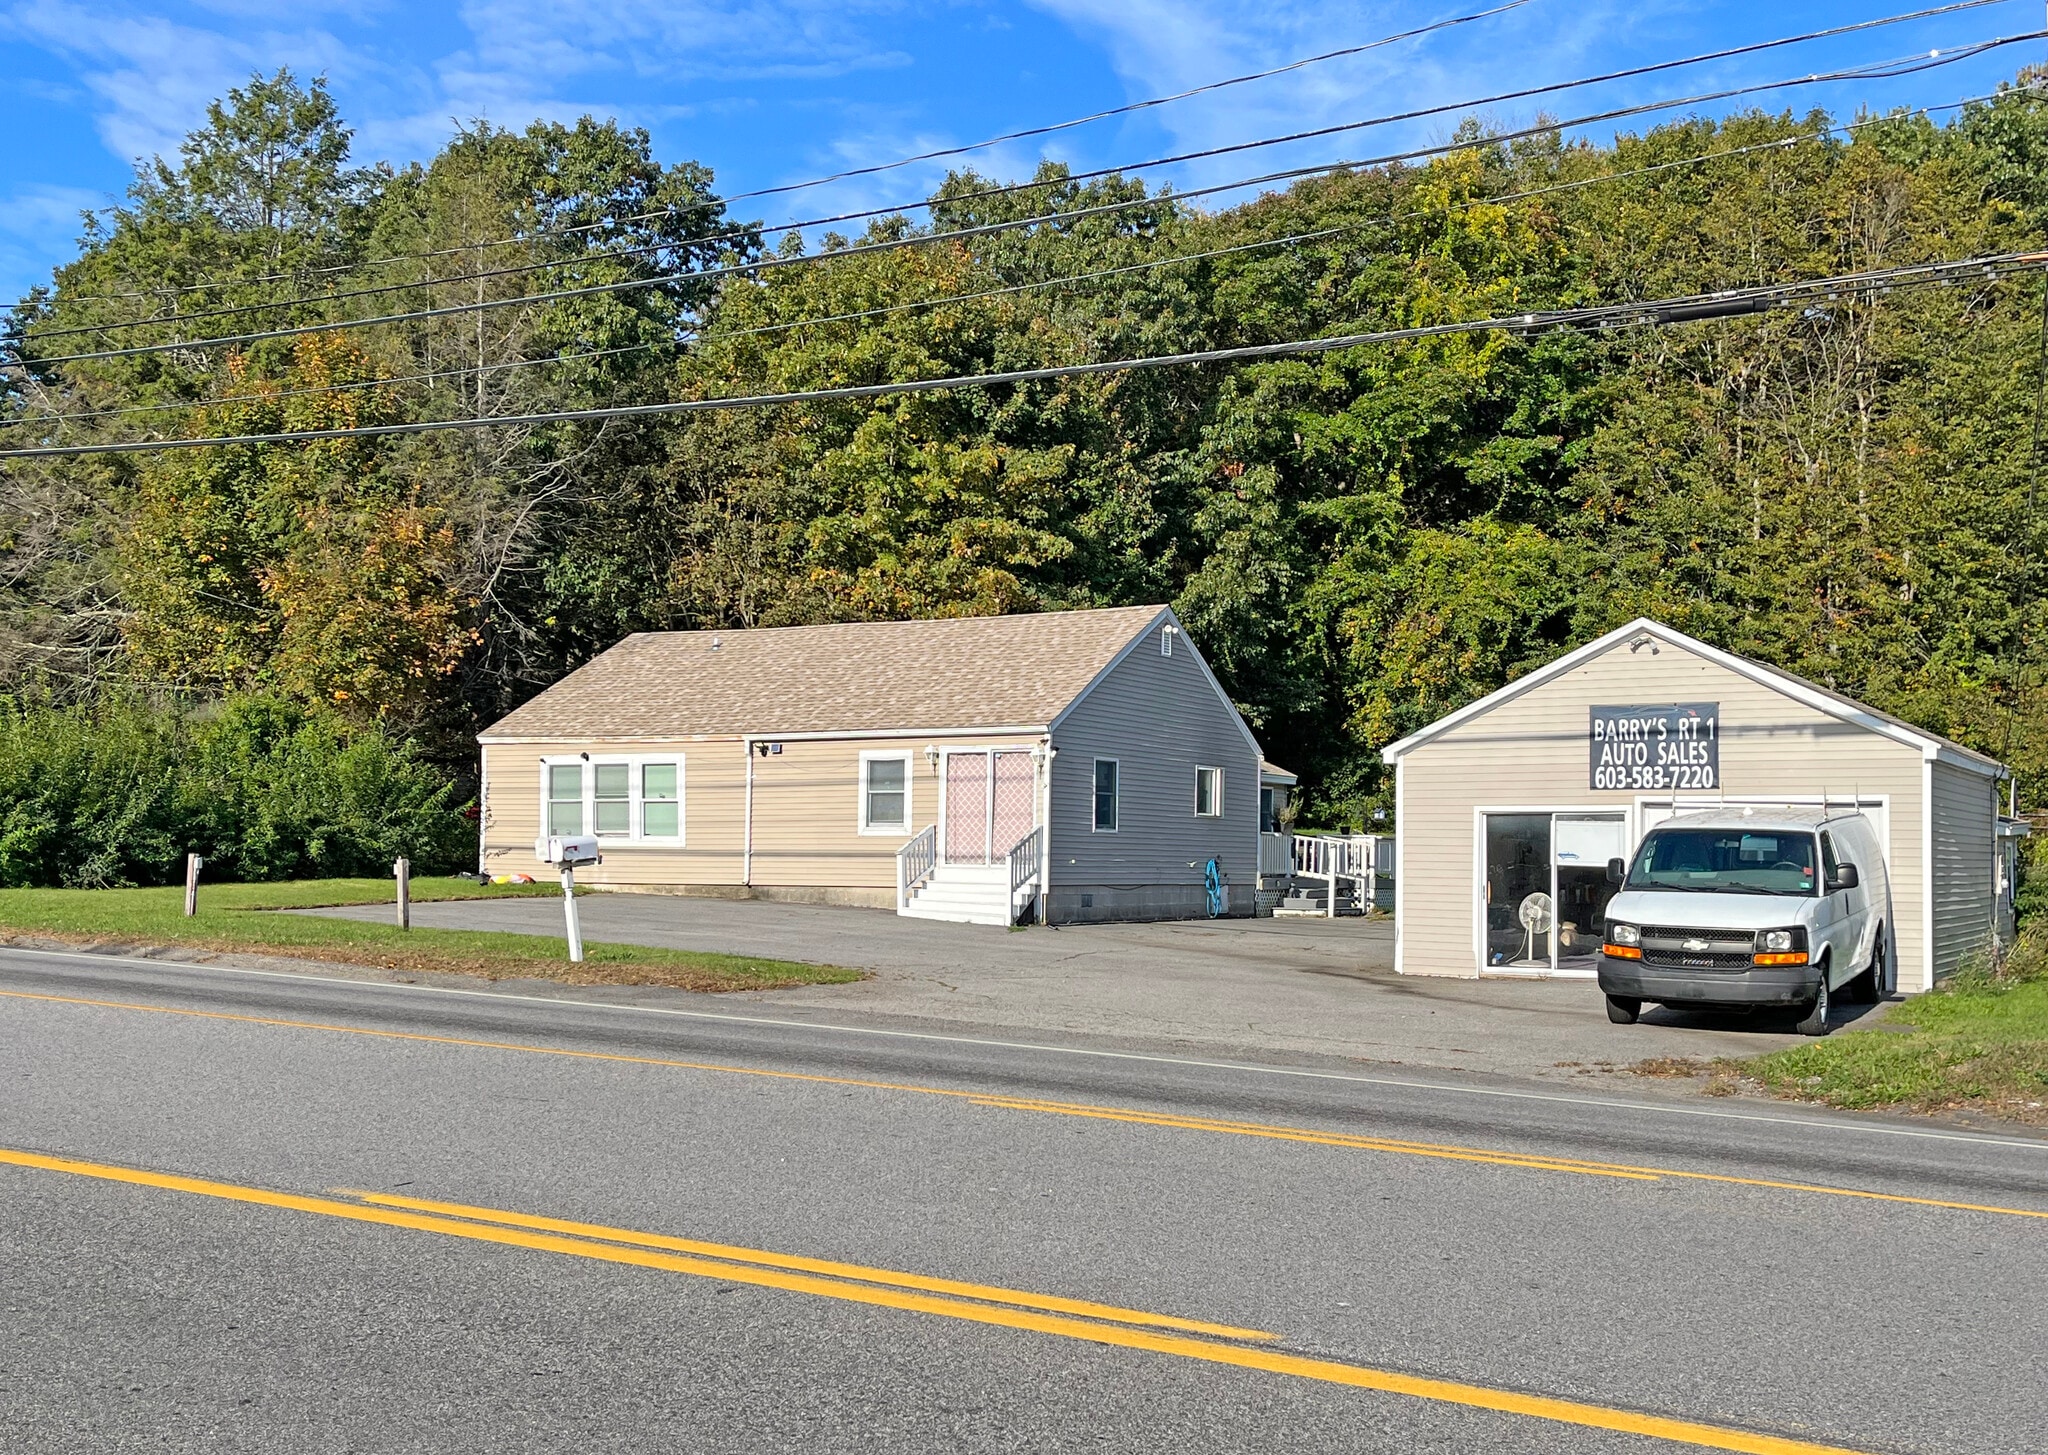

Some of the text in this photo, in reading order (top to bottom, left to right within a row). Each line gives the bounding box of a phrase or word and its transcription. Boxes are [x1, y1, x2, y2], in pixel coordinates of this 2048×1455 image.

[1594, 717, 1714, 741] BARRY'S RT 1
[1600, 741, 1708, 765] AUTO SALES
[1595, 766, 1713, 789] 603-583-7220
